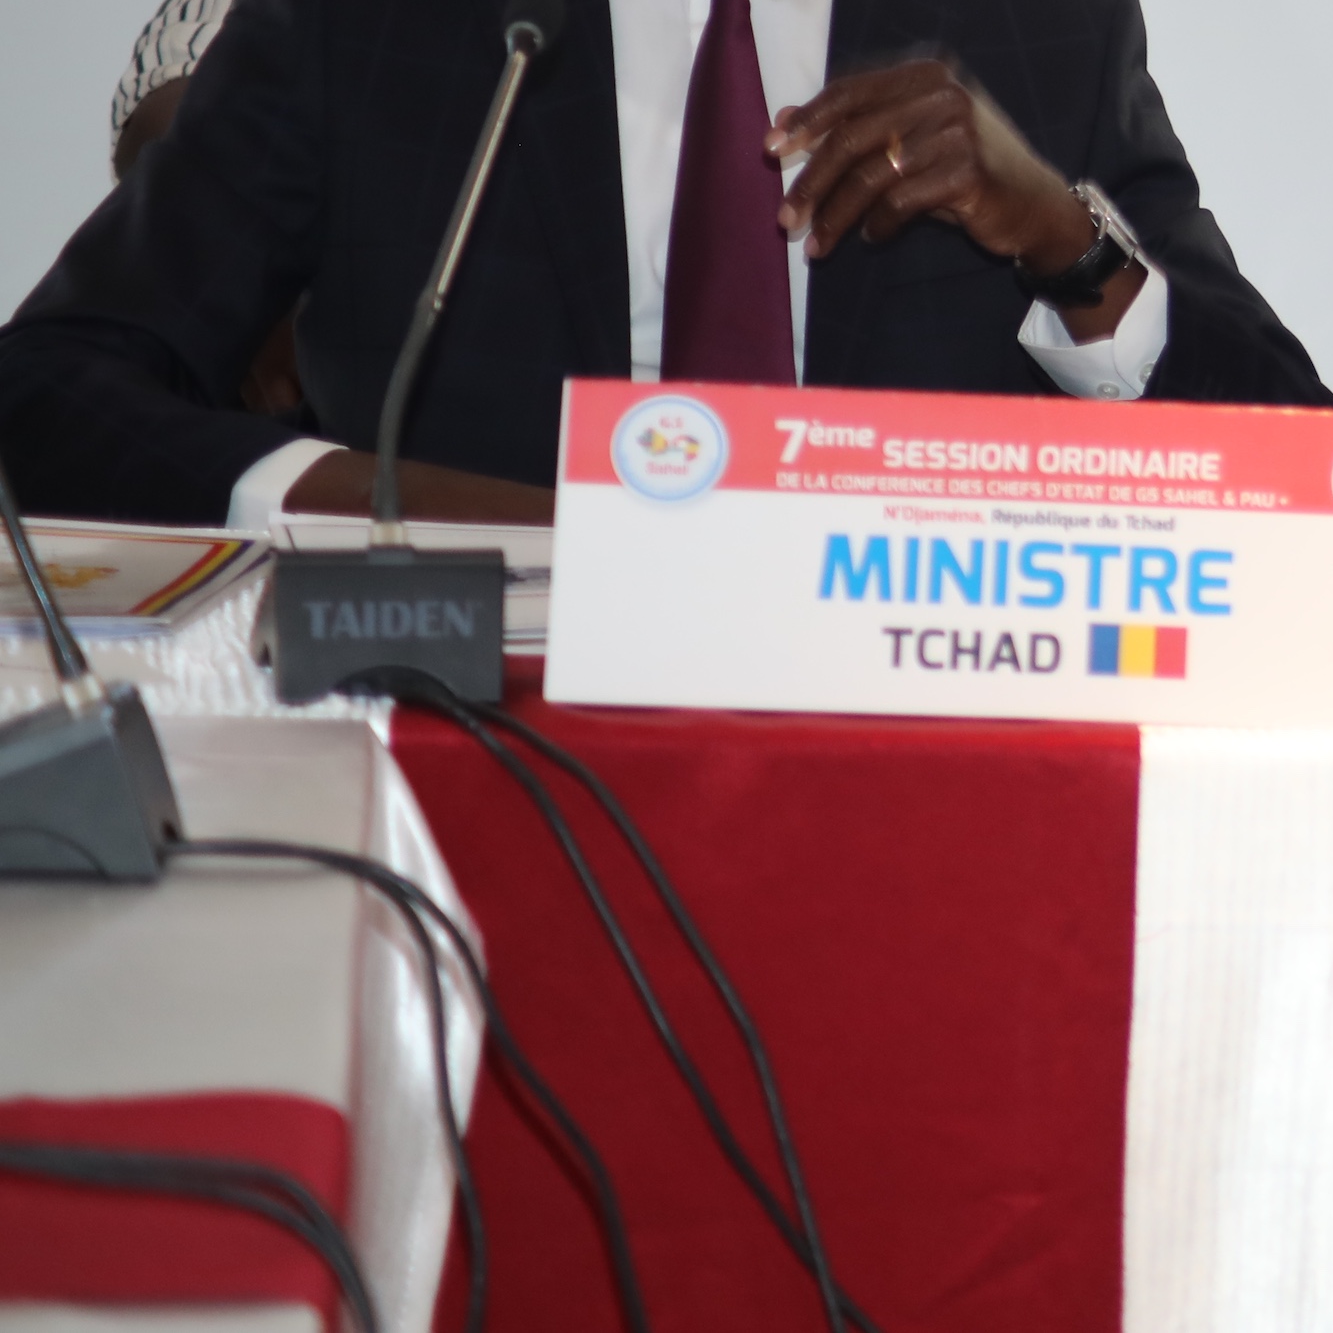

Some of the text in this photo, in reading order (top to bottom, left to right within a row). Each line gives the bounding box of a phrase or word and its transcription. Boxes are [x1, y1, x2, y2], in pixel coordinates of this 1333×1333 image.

[774, 419, 1222, 481] 7ème SESSION ORDINAIRE
[776, 472, 803, 488] DE
[804, 473, 828, 490] LA
[831, 474, 944, 494] CONFERENCE
[948, 478, 983, 495] DES
[986, 480, 1042, 498] CHEFS
[1046, 482, 1104, 501] D'ETAT
[1109, 485, 1132, 502] DE
[1135, 486, 1160, 503] G5
[1163, 487, 1218, 506] SAHEL
[1222, 491, 1235, 507] &
[1239, 491, 1276, 508] PAU
[991, 509, 1091, 530] République
[1097, 513, 1119, 528] du
[1126, 515, 1175, 532] Tchad
[817, 533, 1236, 618] MINISTRE
[303, 601, 477, 639] TAIDEN
[883, 626, 1063, 675] TCHAD
